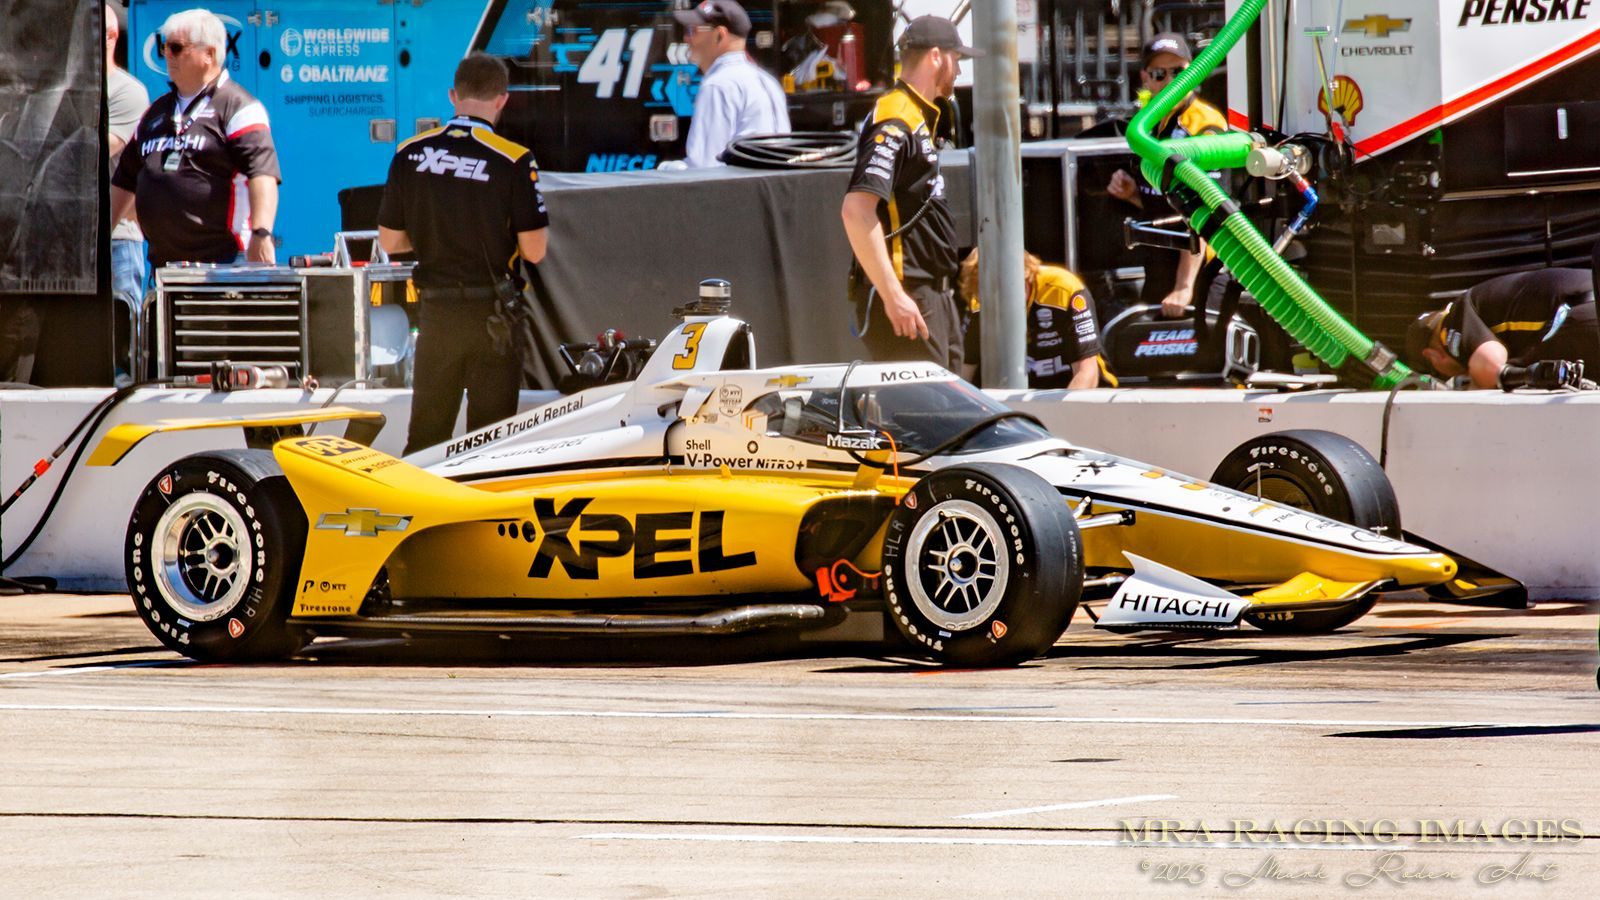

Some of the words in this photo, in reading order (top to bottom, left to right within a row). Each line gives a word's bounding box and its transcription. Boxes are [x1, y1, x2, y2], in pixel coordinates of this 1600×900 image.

[1458, 0, 1592, 27] PENSKE
[303, 28, 390, 43] WORLDWIDE
[304, 43, 361, 57] EXPRESS
[1341, 45, 1414, 57] CHEVROLET
[577, 27, 655, 99] 41
[141, 134, 207, 157] HITACHI
[415, 146, 490, 182] XPEL
[672, 322, 709, 370] 3
[1149, 329, 1195, 341] TEAM
[1135, 342, 1198, 357] PENSKE
[446, 426, 502, 458] PENSKE
[506, 413, 540, 436] Truck
[543, 396, 584, 421] Rental
[686, 440, 711, 450] Shell
[826, 434, 881, 450] Mazak
[686, 453, 753, 468] V-Power
[1250, 445, 1334, 496] Firestone
[207, 470, 265, 583] Firestone
[965, 479, 1025, 566] Firestone
[527, 497, 757, 580] XPEL
[300, 604, 351, 612] Firestone
[1119, 592, 1231, 618] HITACHI
